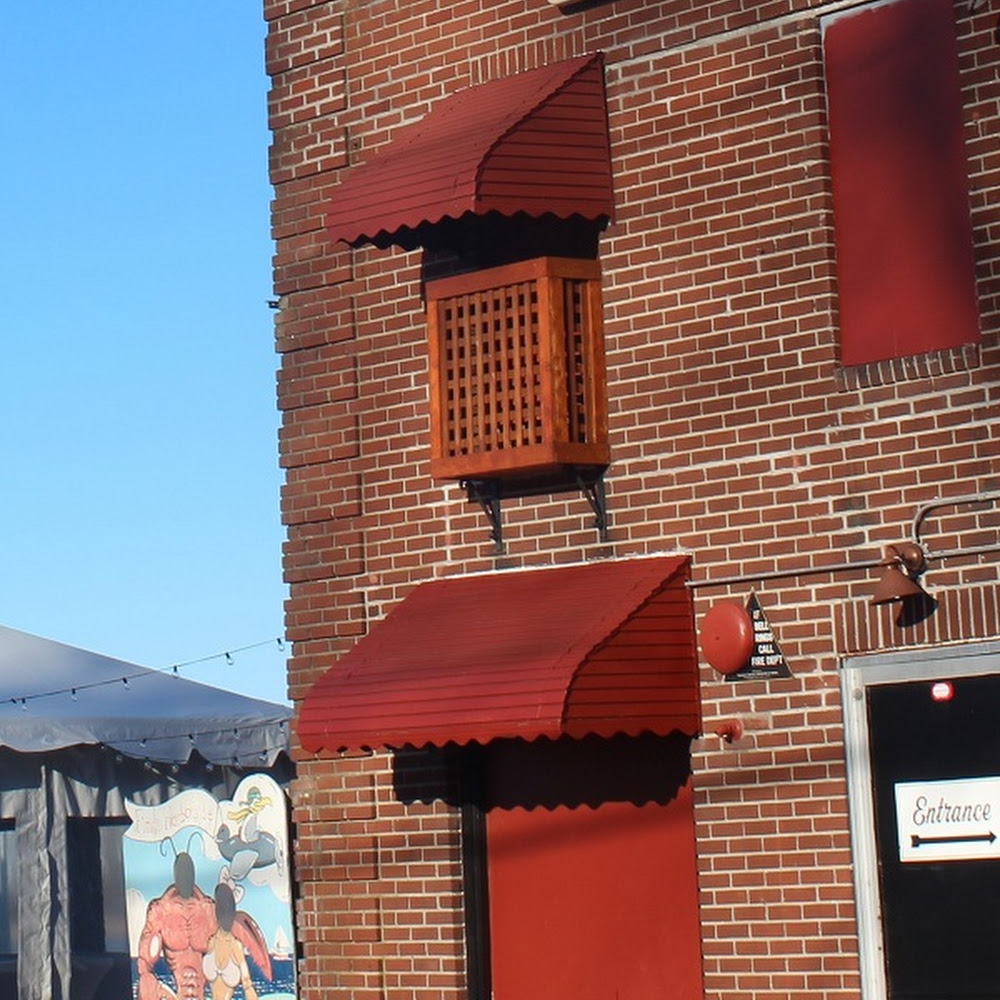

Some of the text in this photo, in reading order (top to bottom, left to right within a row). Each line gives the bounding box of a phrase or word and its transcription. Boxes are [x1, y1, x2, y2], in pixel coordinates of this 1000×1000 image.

[754, 621, 769, 632] BELL
[758, 644, 774, 654] CALL
[751, 656, 766, 667] FIRE
[912, 795, 991, 827] Entrance
